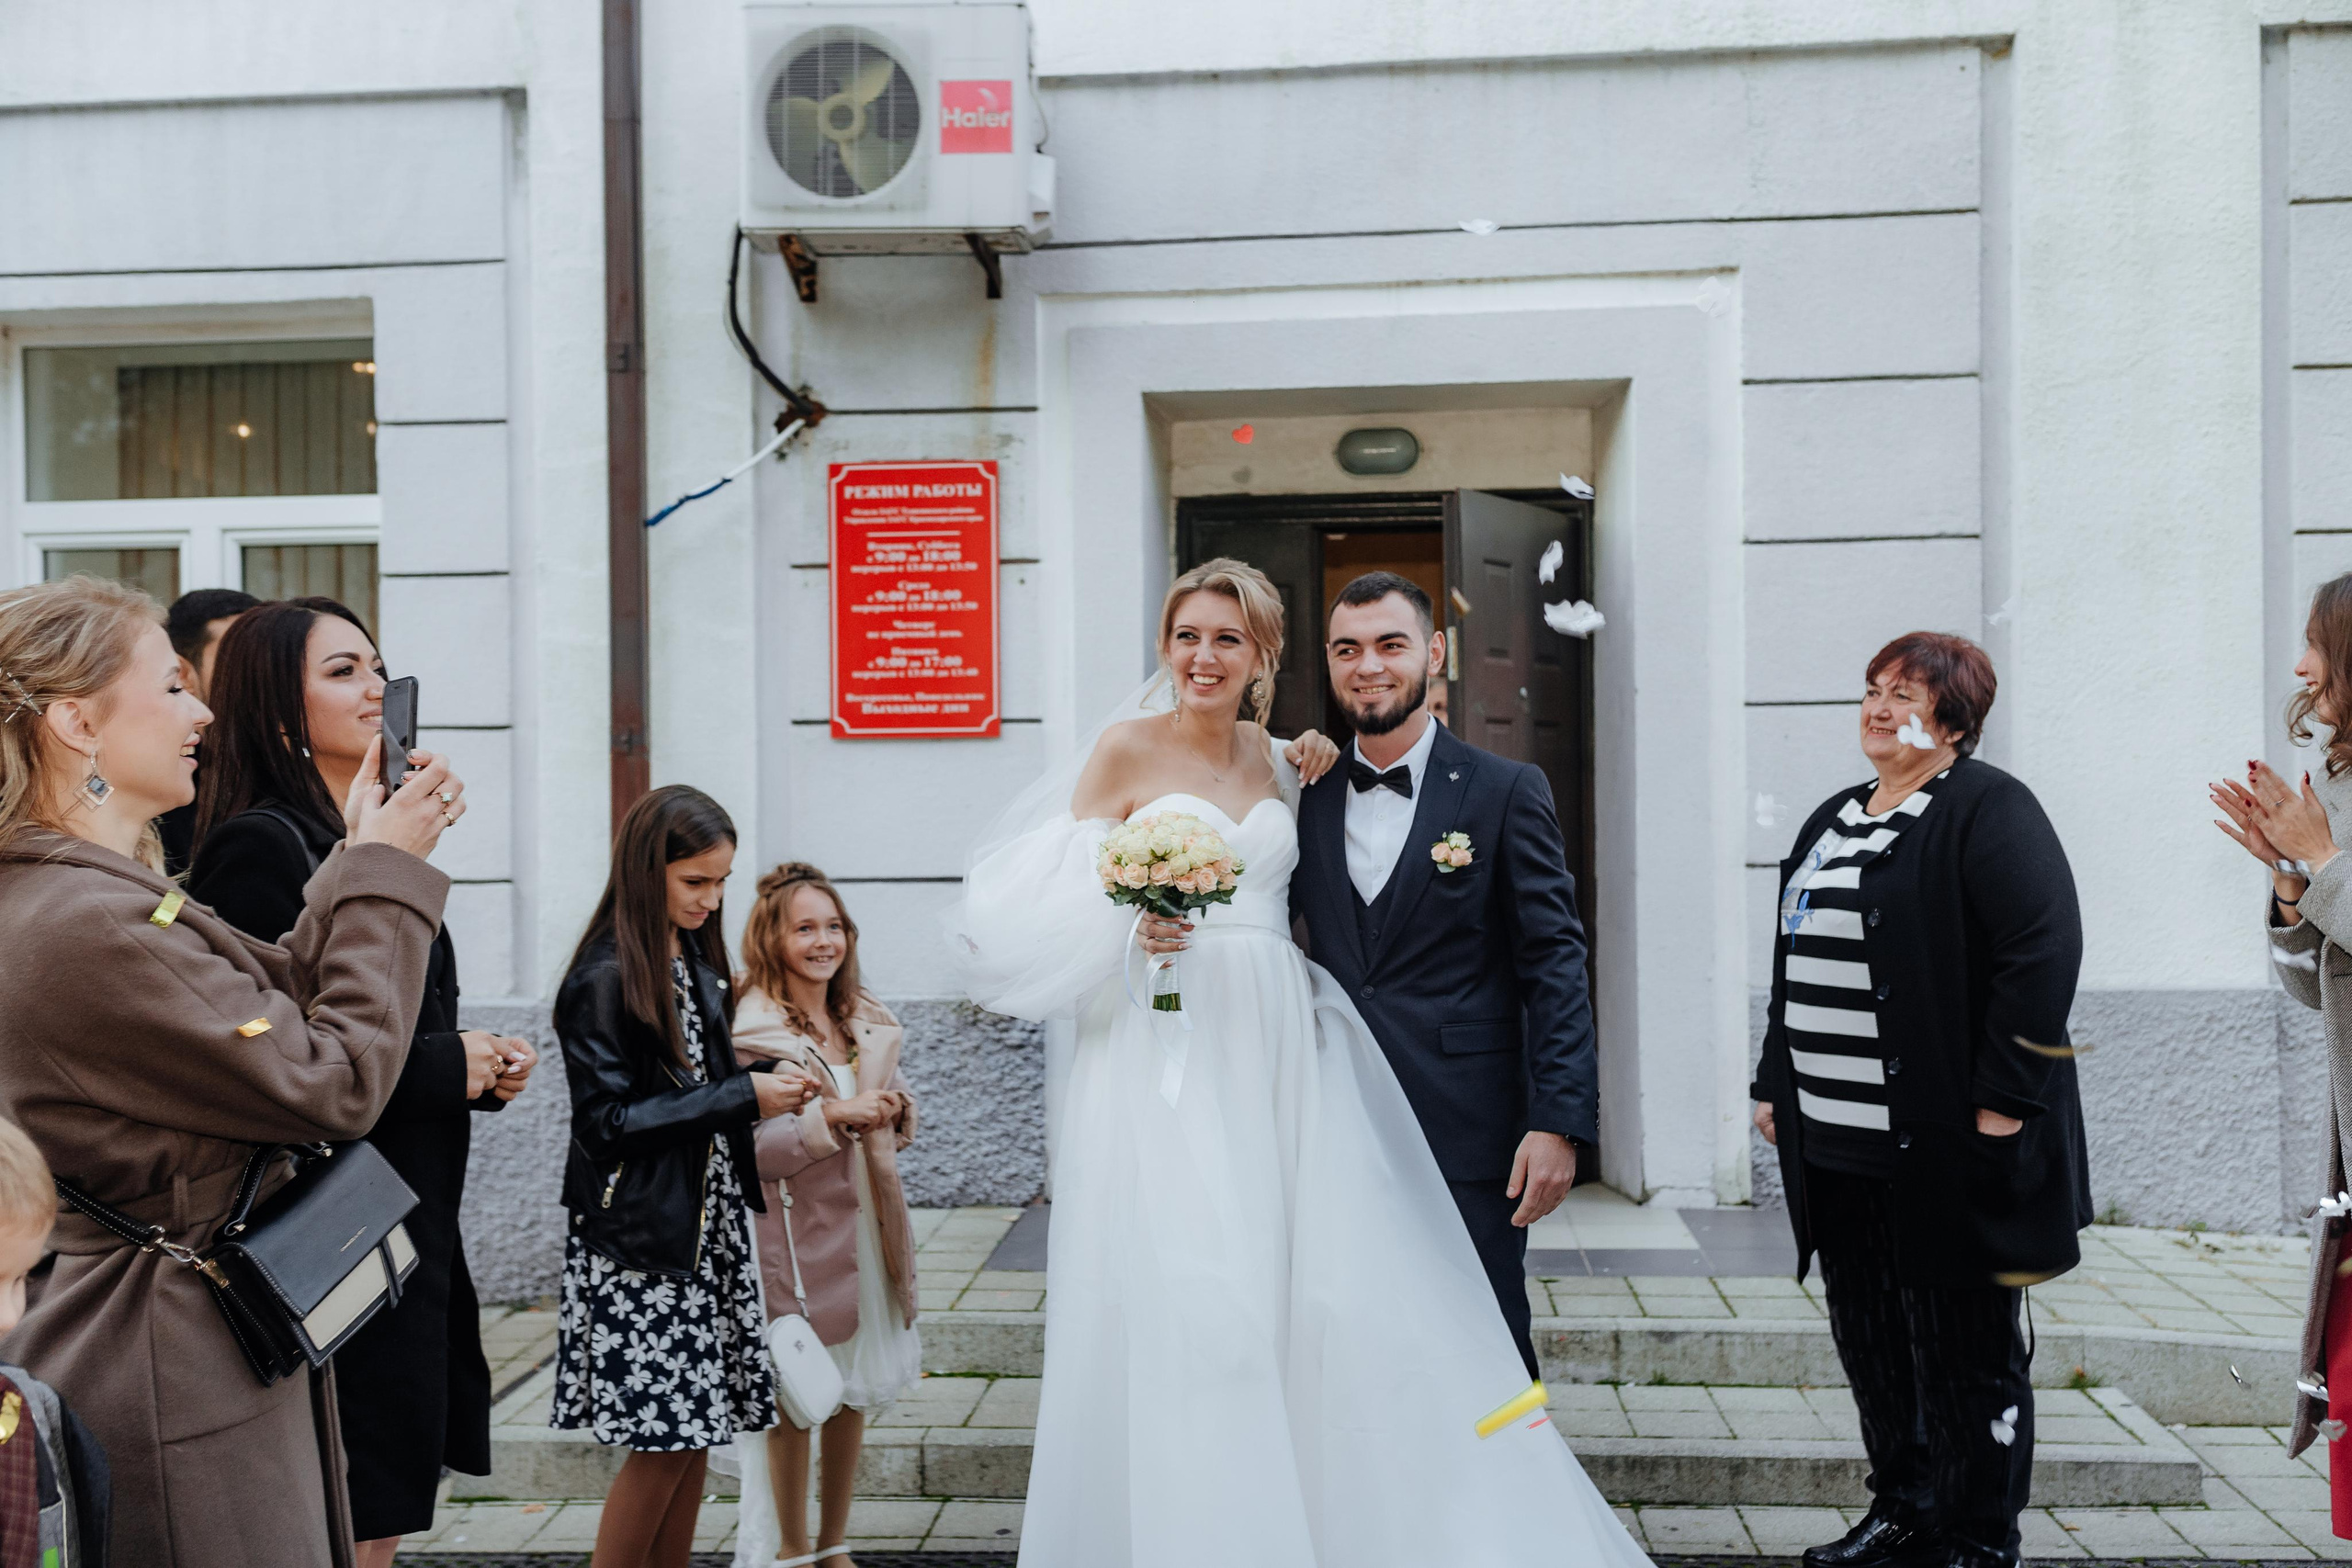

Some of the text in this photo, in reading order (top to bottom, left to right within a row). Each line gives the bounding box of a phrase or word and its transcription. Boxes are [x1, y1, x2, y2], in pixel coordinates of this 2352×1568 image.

[941, 107, 1011, 128] Haier
[843, 483, 982, 499] РЕЖИМ РАБОТЫ
